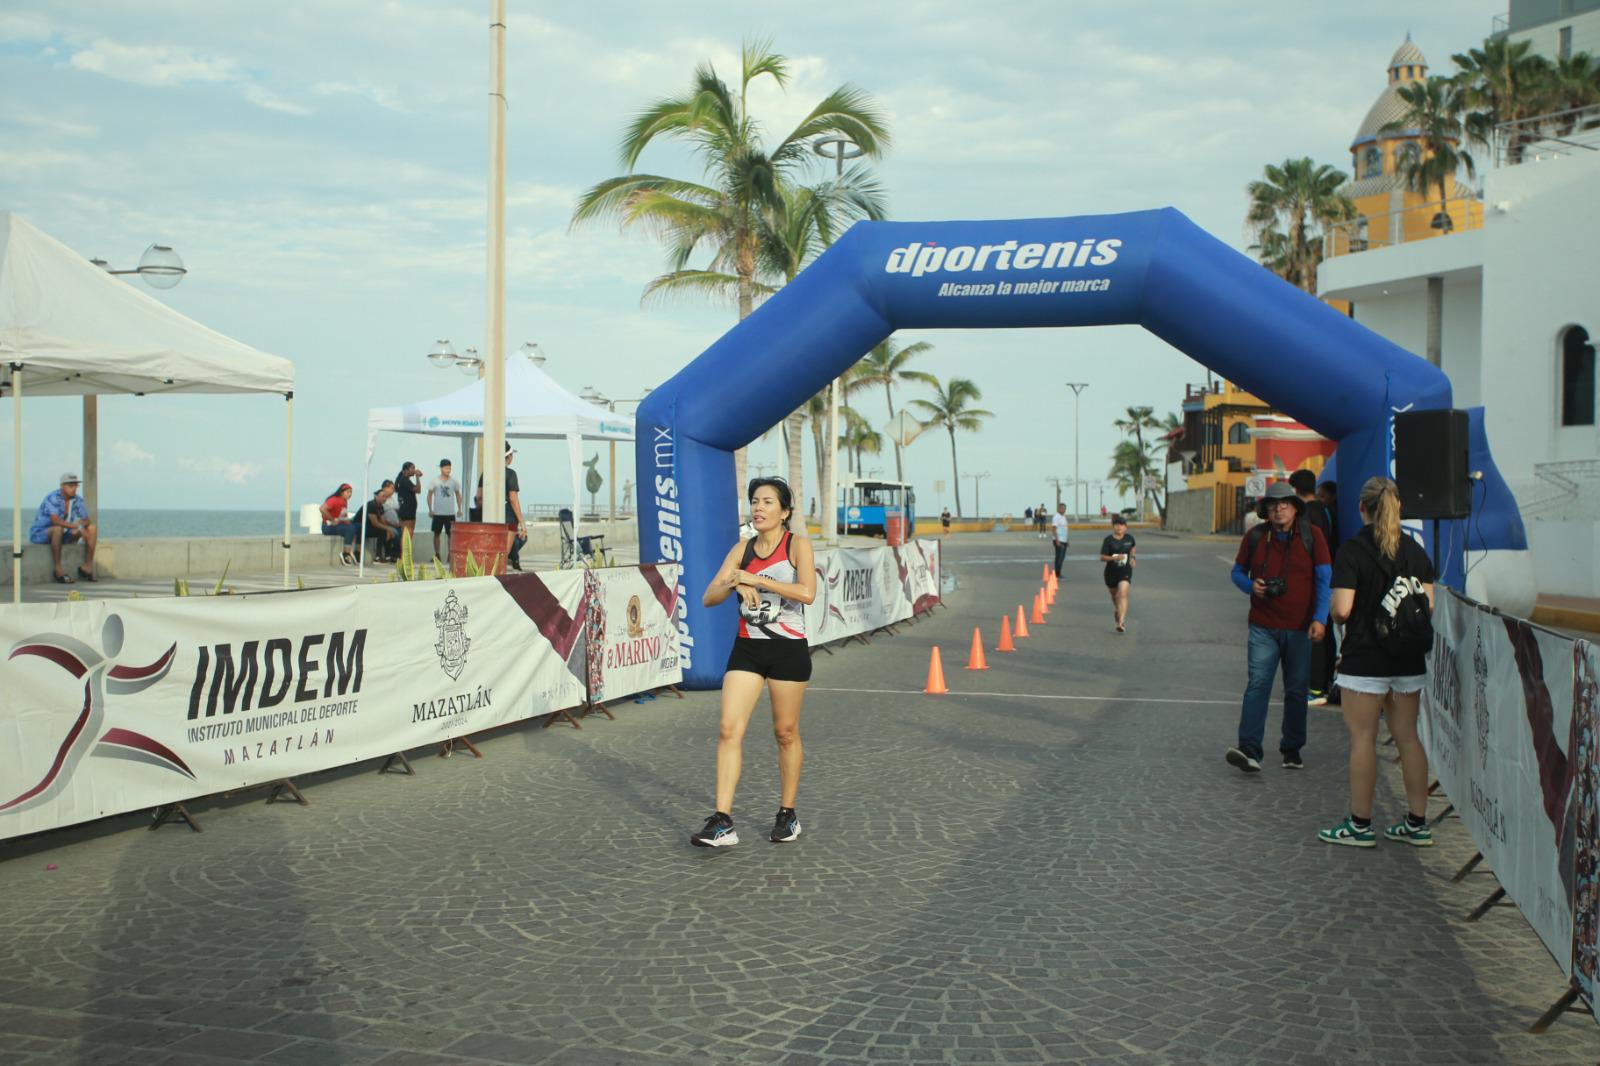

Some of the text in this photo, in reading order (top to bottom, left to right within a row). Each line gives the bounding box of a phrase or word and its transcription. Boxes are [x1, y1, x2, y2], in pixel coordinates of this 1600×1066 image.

[885, 238, 1122, 277] dportenis
[938, 278, 1110, 297] Alcanza la mejor marca
[614, 635, 661, 669] MARINO
[187, 629, 367, 720] IMDEM
[188, 700, 358, 743] INSTITUTO MUNICIPAL DEL DEPORTE
[412, 685, 492, 723] MAZATLÁN
[224, 728, 334, 765] MAZATLÁN
